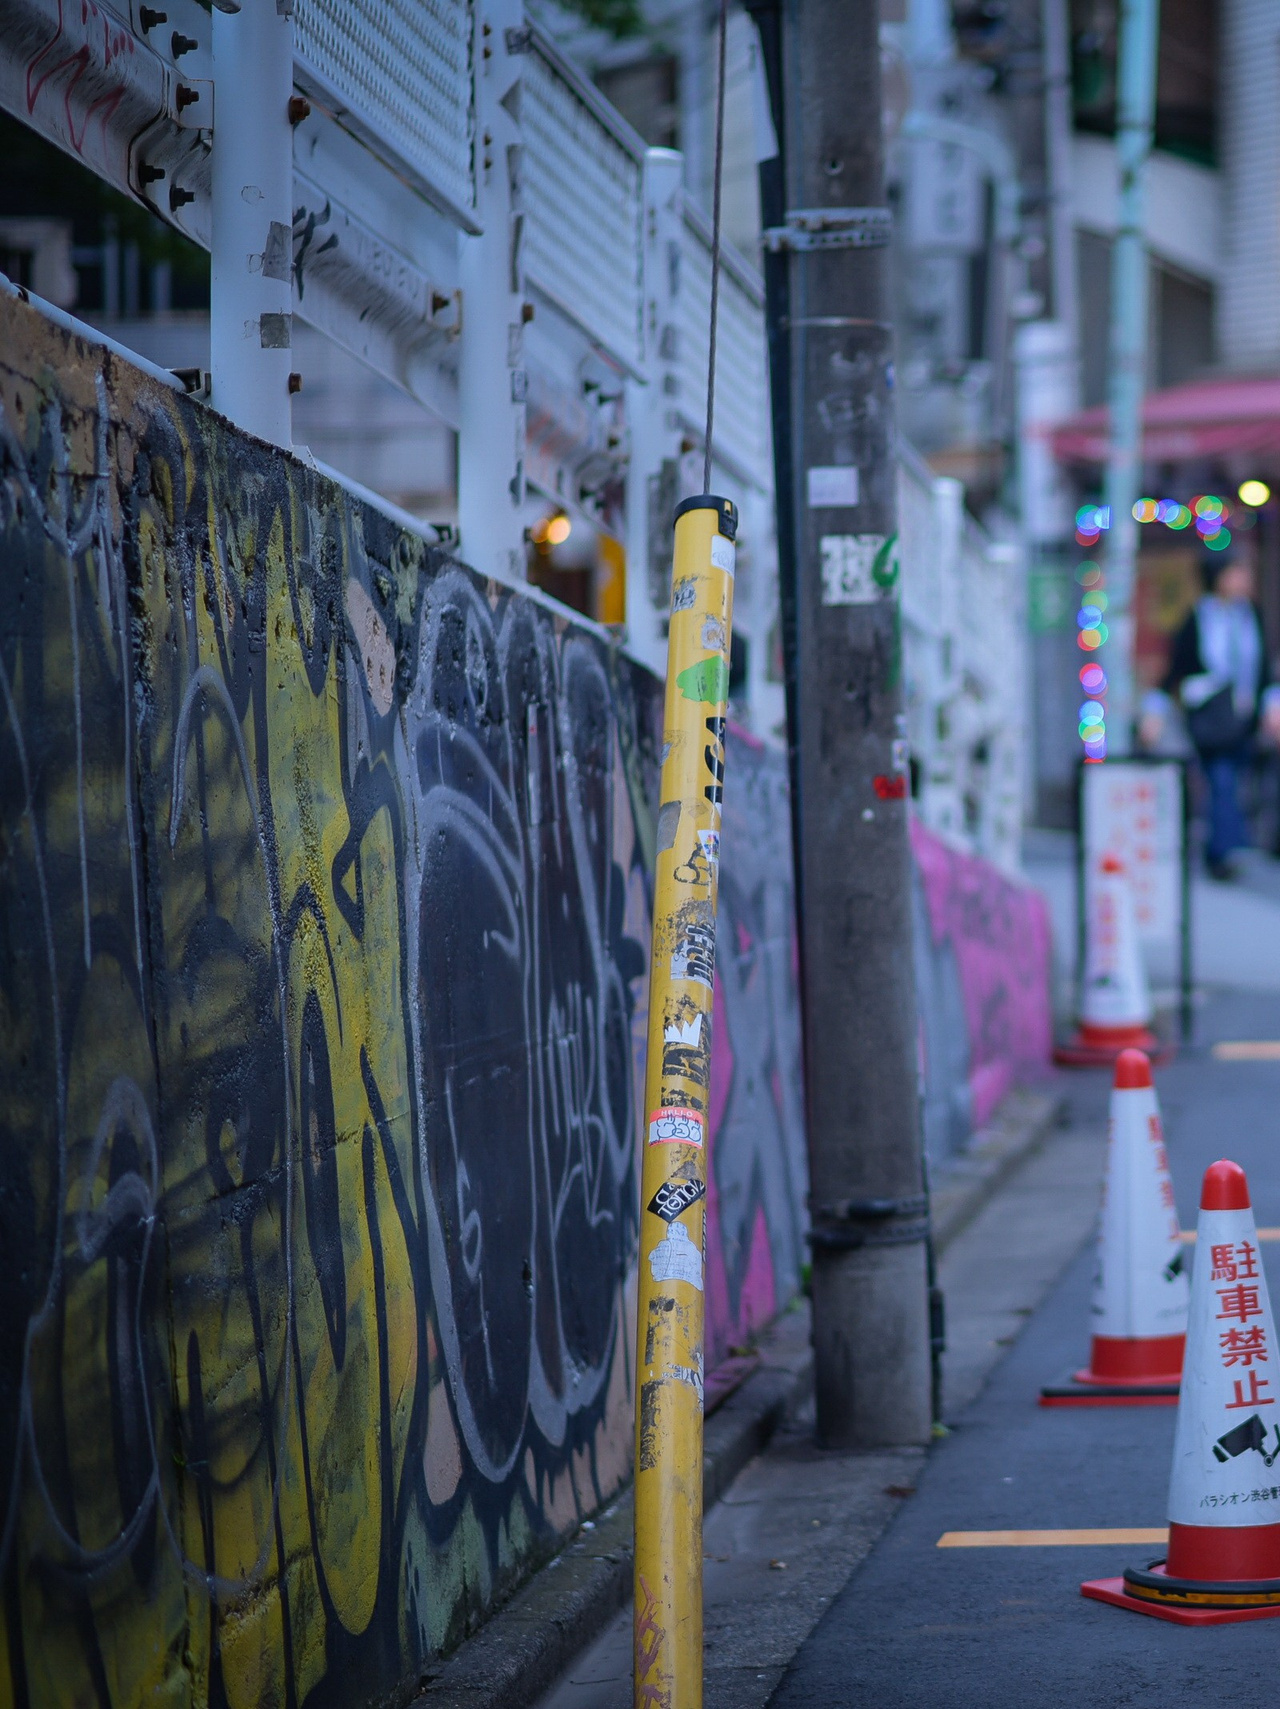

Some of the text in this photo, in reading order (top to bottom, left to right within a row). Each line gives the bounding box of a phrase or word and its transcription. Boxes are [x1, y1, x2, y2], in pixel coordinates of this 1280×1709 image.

[661, 1109, 694, 1117] HELLO
[1210, 1240, 1275, 1409] 駐車禁止
